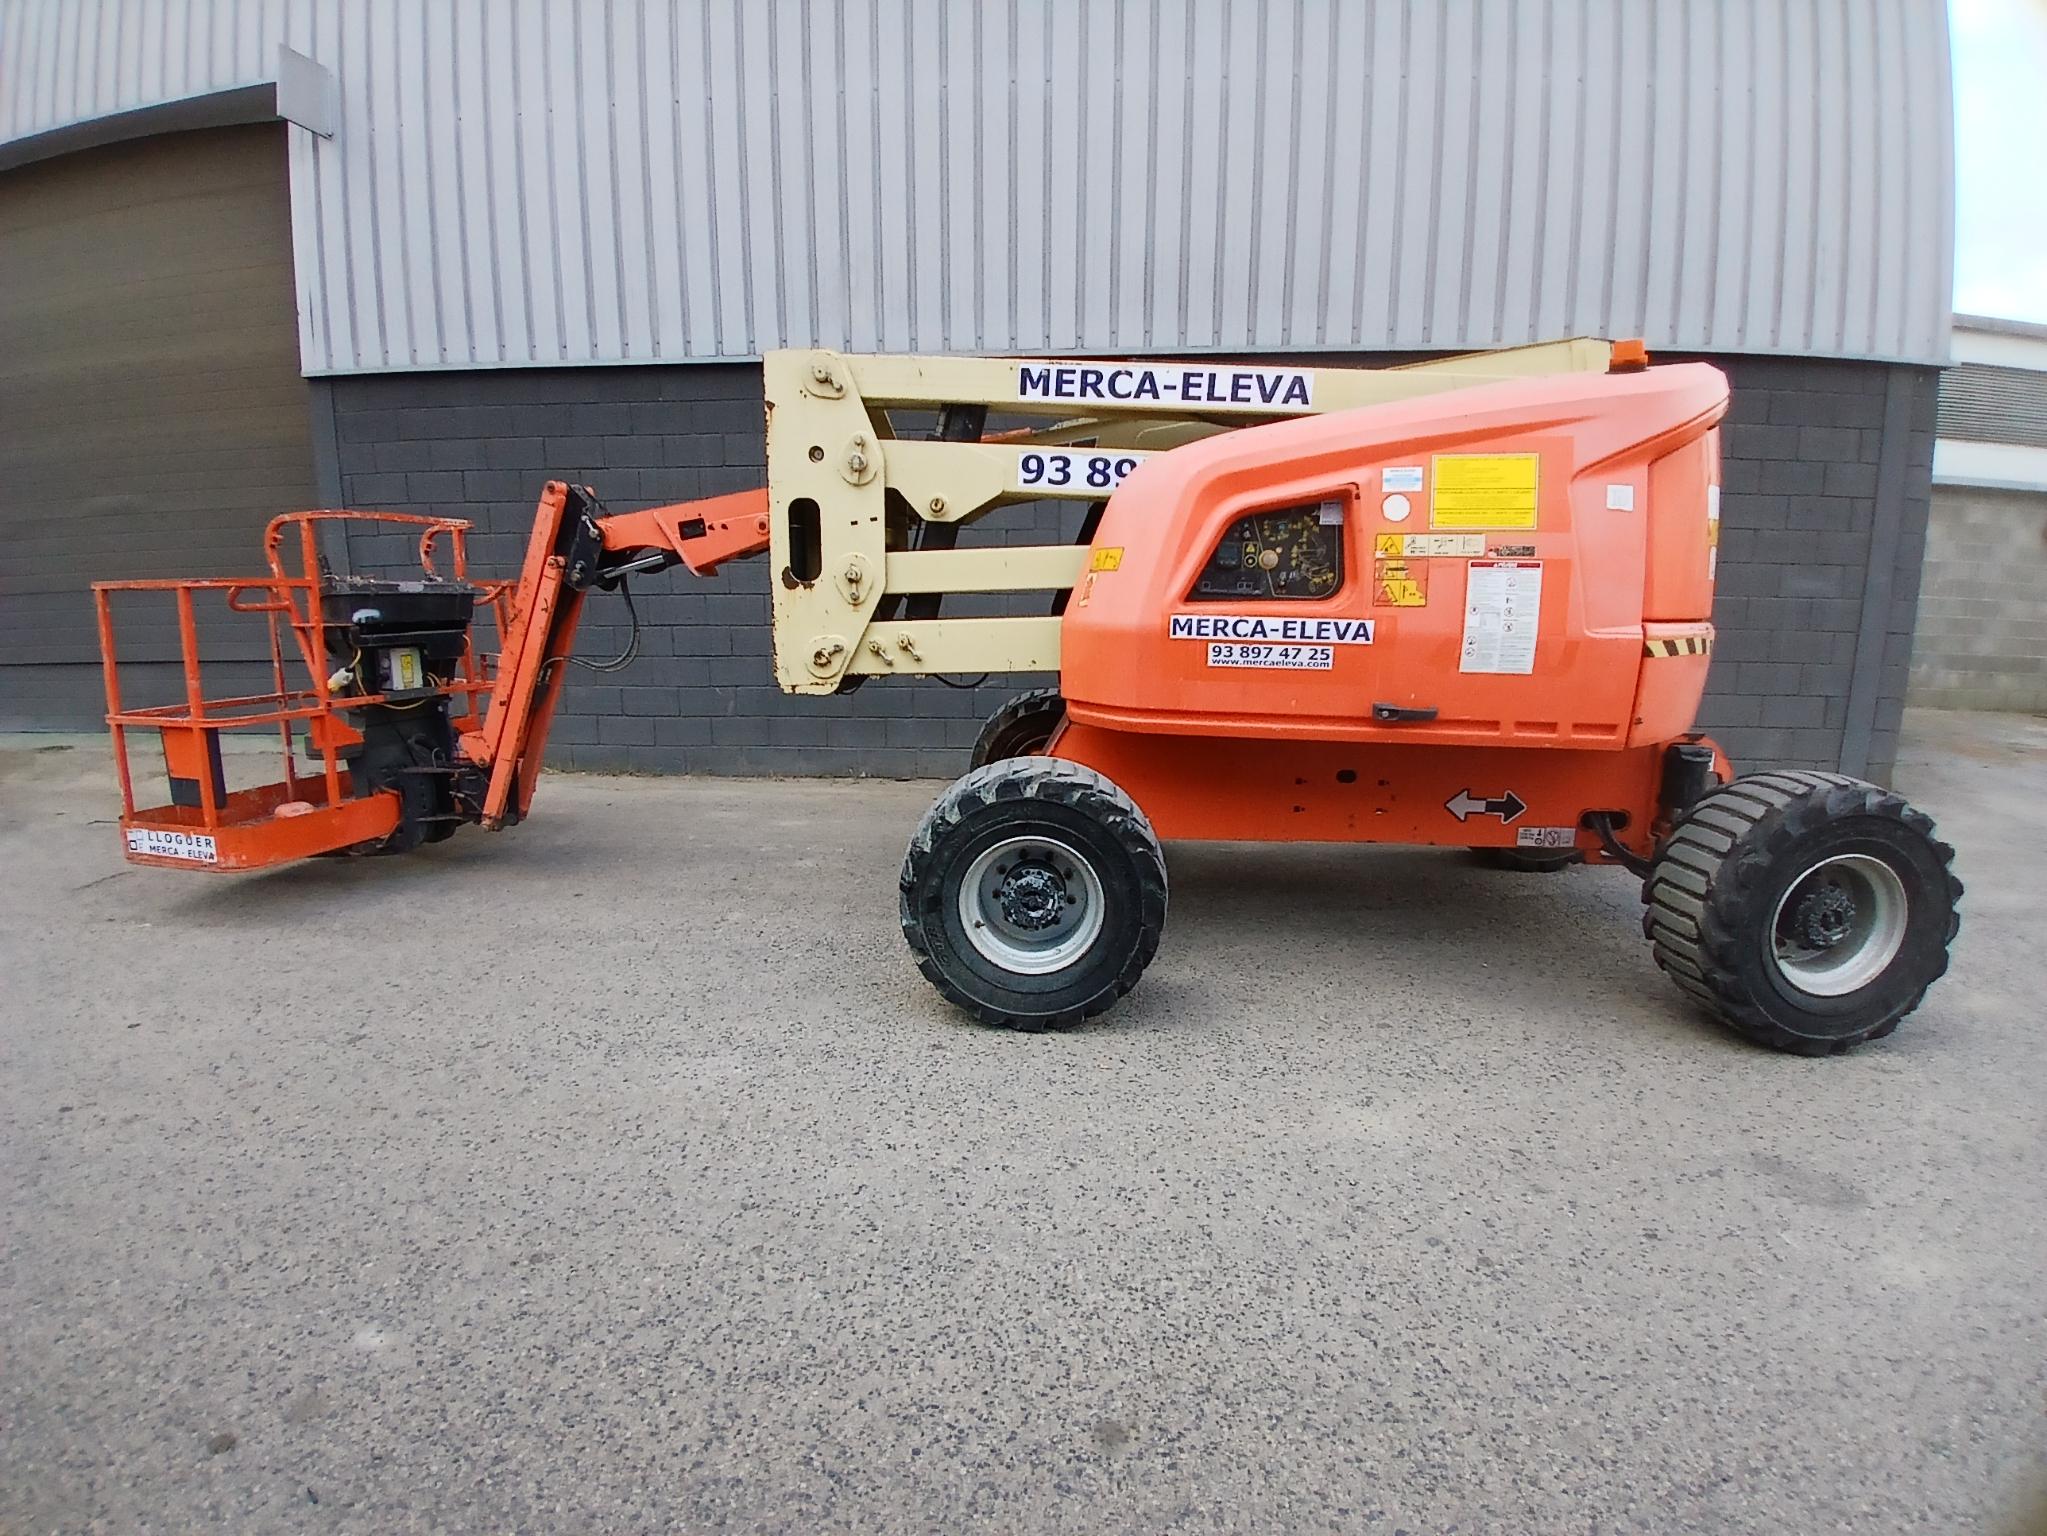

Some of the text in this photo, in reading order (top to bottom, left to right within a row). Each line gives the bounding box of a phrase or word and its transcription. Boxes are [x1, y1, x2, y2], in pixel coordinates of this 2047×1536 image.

[1019, 367, 1310, 406] MERCA-ELEVA
[1021, 453, 1072, 486] 93
[1171, 618, 1371, 641] MERCA-ELEVA
[1211, 645, 1330, 661] 93 897 47 25
[1211, 658, 1330, 668] www.mercaeleva.com
[149, 845, 179, 856] MERCA
[187, 850, 215, 860] ELEVA
